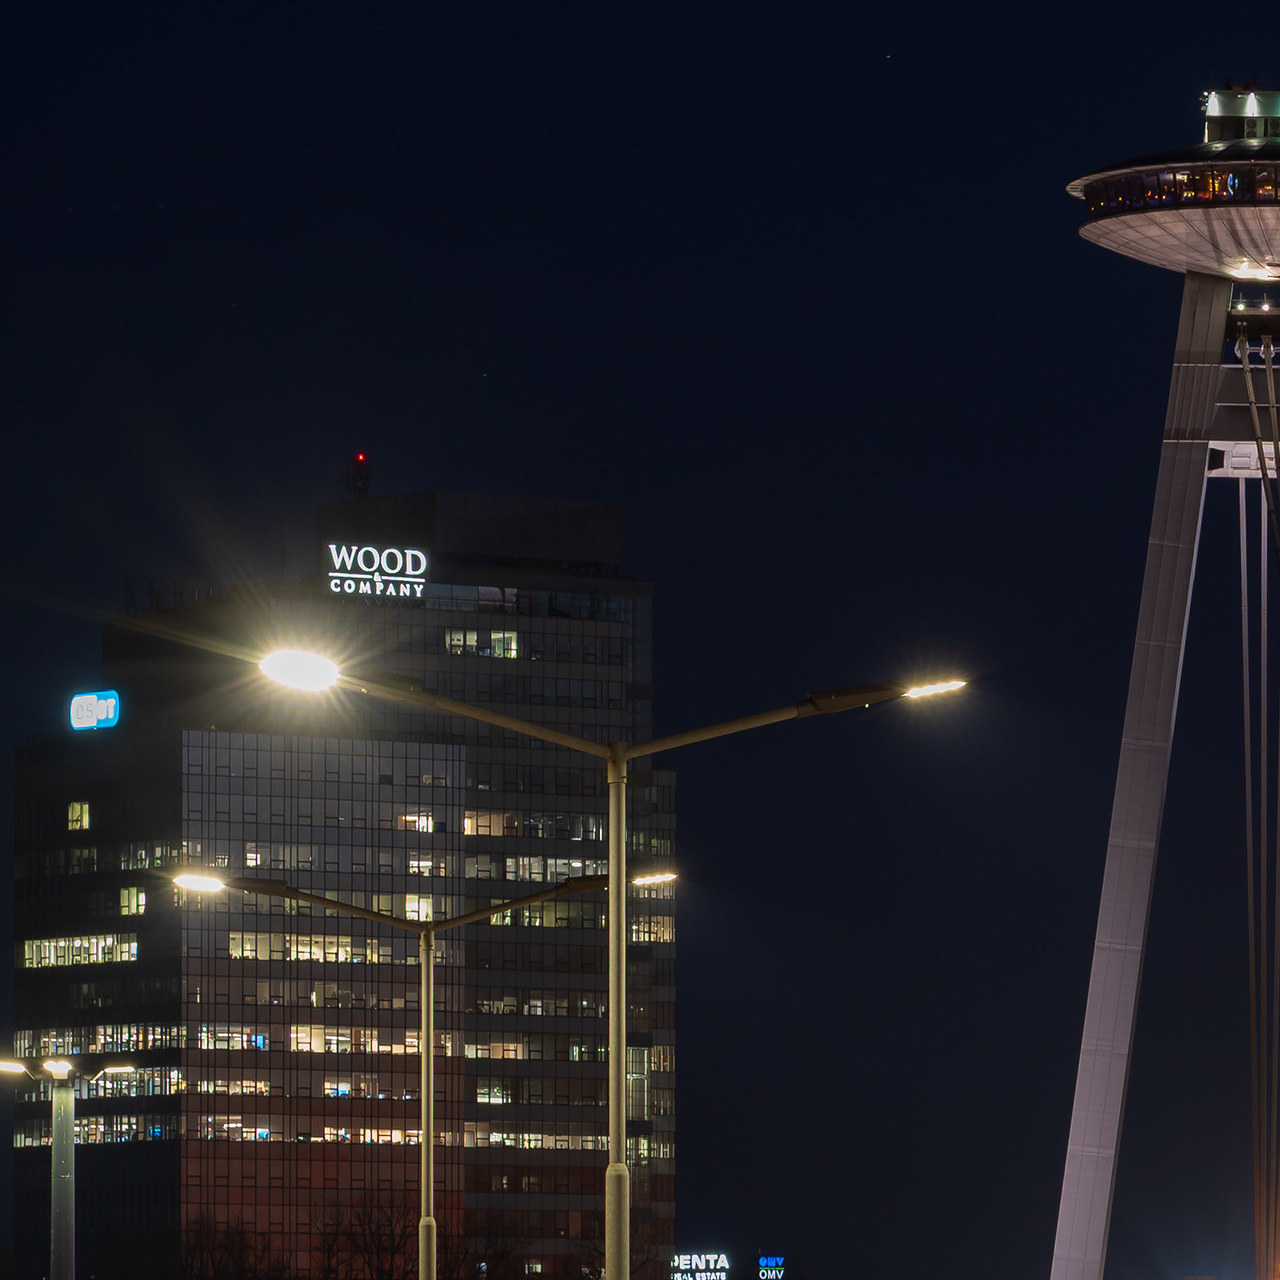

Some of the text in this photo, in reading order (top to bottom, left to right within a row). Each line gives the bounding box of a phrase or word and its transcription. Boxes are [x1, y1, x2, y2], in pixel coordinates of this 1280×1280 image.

[328, 544, 427, 575] WOOD
[373, 572, 382, 581] &
[330, 579, 424, 597] COMPANY
[695, 1272, 727, 1280] ESTATE
[758, 1269, 785, 1280] OMV
